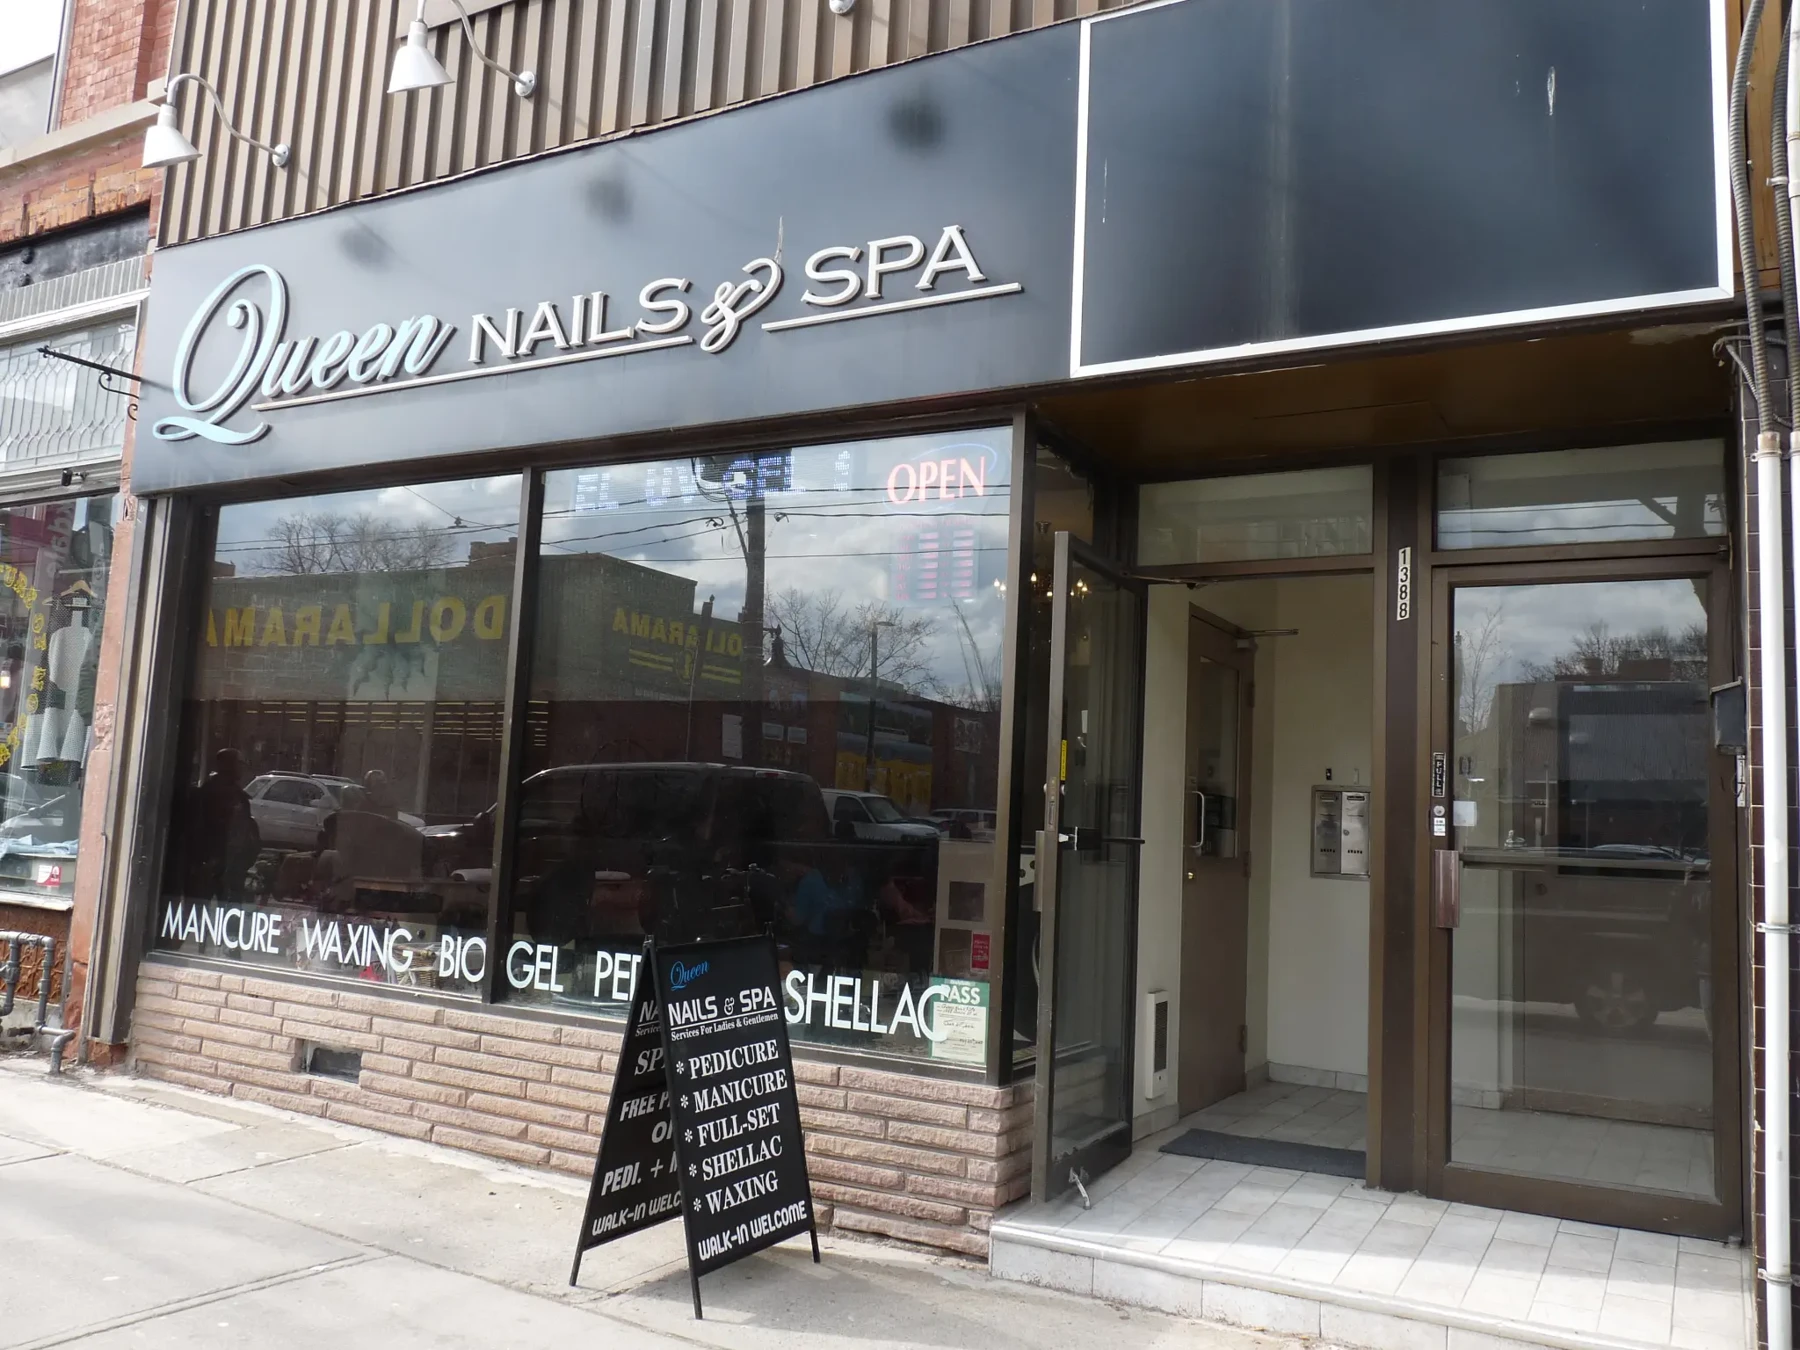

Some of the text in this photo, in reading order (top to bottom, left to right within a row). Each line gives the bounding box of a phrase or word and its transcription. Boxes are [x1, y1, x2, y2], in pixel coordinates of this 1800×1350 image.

[153, 225, 986, 443] Queen NAILS & SPA
[887, 456, 985, 504] OPEN
[1399, 549, 1410, 618] 1388
[161, 901, 486, 983] MANICURE WAXING BIO
[507, 940, 563, 992] GEL
[784, 969, 950, 1041] SHELLAC
[670, 961, 710, 991] Queen
[668, 986, 776, 1026] NAILS & SPA
[671, 1012, 778, 1041] Services For Ladies & Gentlemen
[688, 1039, 779, 1079] PEDICURE
[620, 1094, 657, 1121] FREE
[693, 1069, 788, 1113] MANICURE
[697, 1103, 780, 1147] FULL-SET
[601, 1162, 641, 1196] PEDI.
[702, 1135, 783, 1181] SHELLAC
[705, 1170, 779, 1214] WAXING
